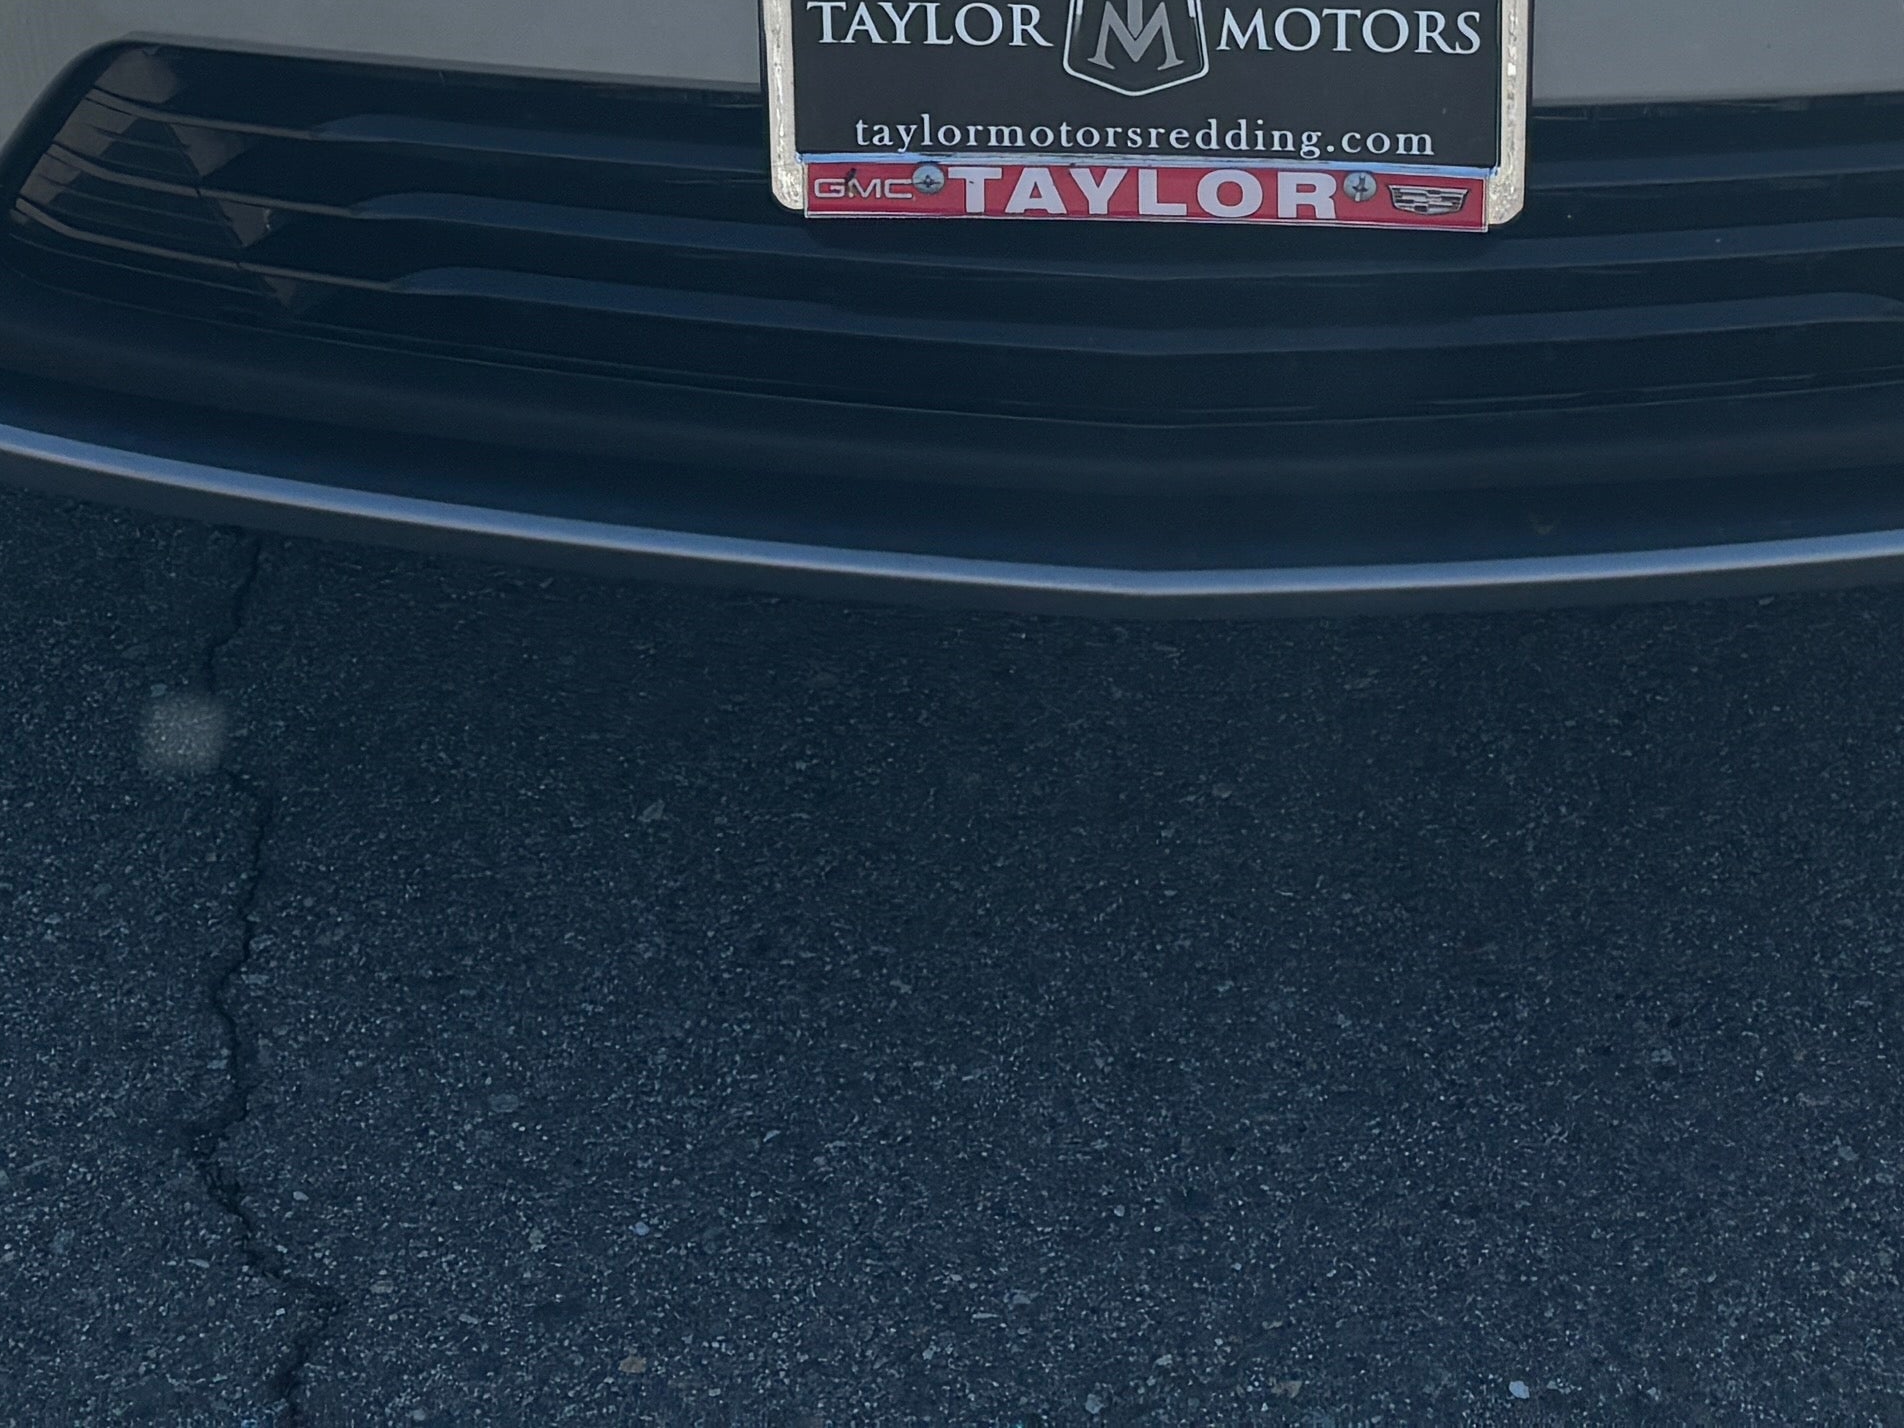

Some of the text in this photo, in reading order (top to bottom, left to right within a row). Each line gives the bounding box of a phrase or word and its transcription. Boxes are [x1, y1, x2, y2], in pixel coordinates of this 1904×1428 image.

[806, 0, 1055, 47] TAYLOR
[1216, 7, 1481, 55] MOTORS
[854, 114, 1435, 159] taylormotorsredding.com
[814, 166, 1337, 220] GMC TAYLOR
